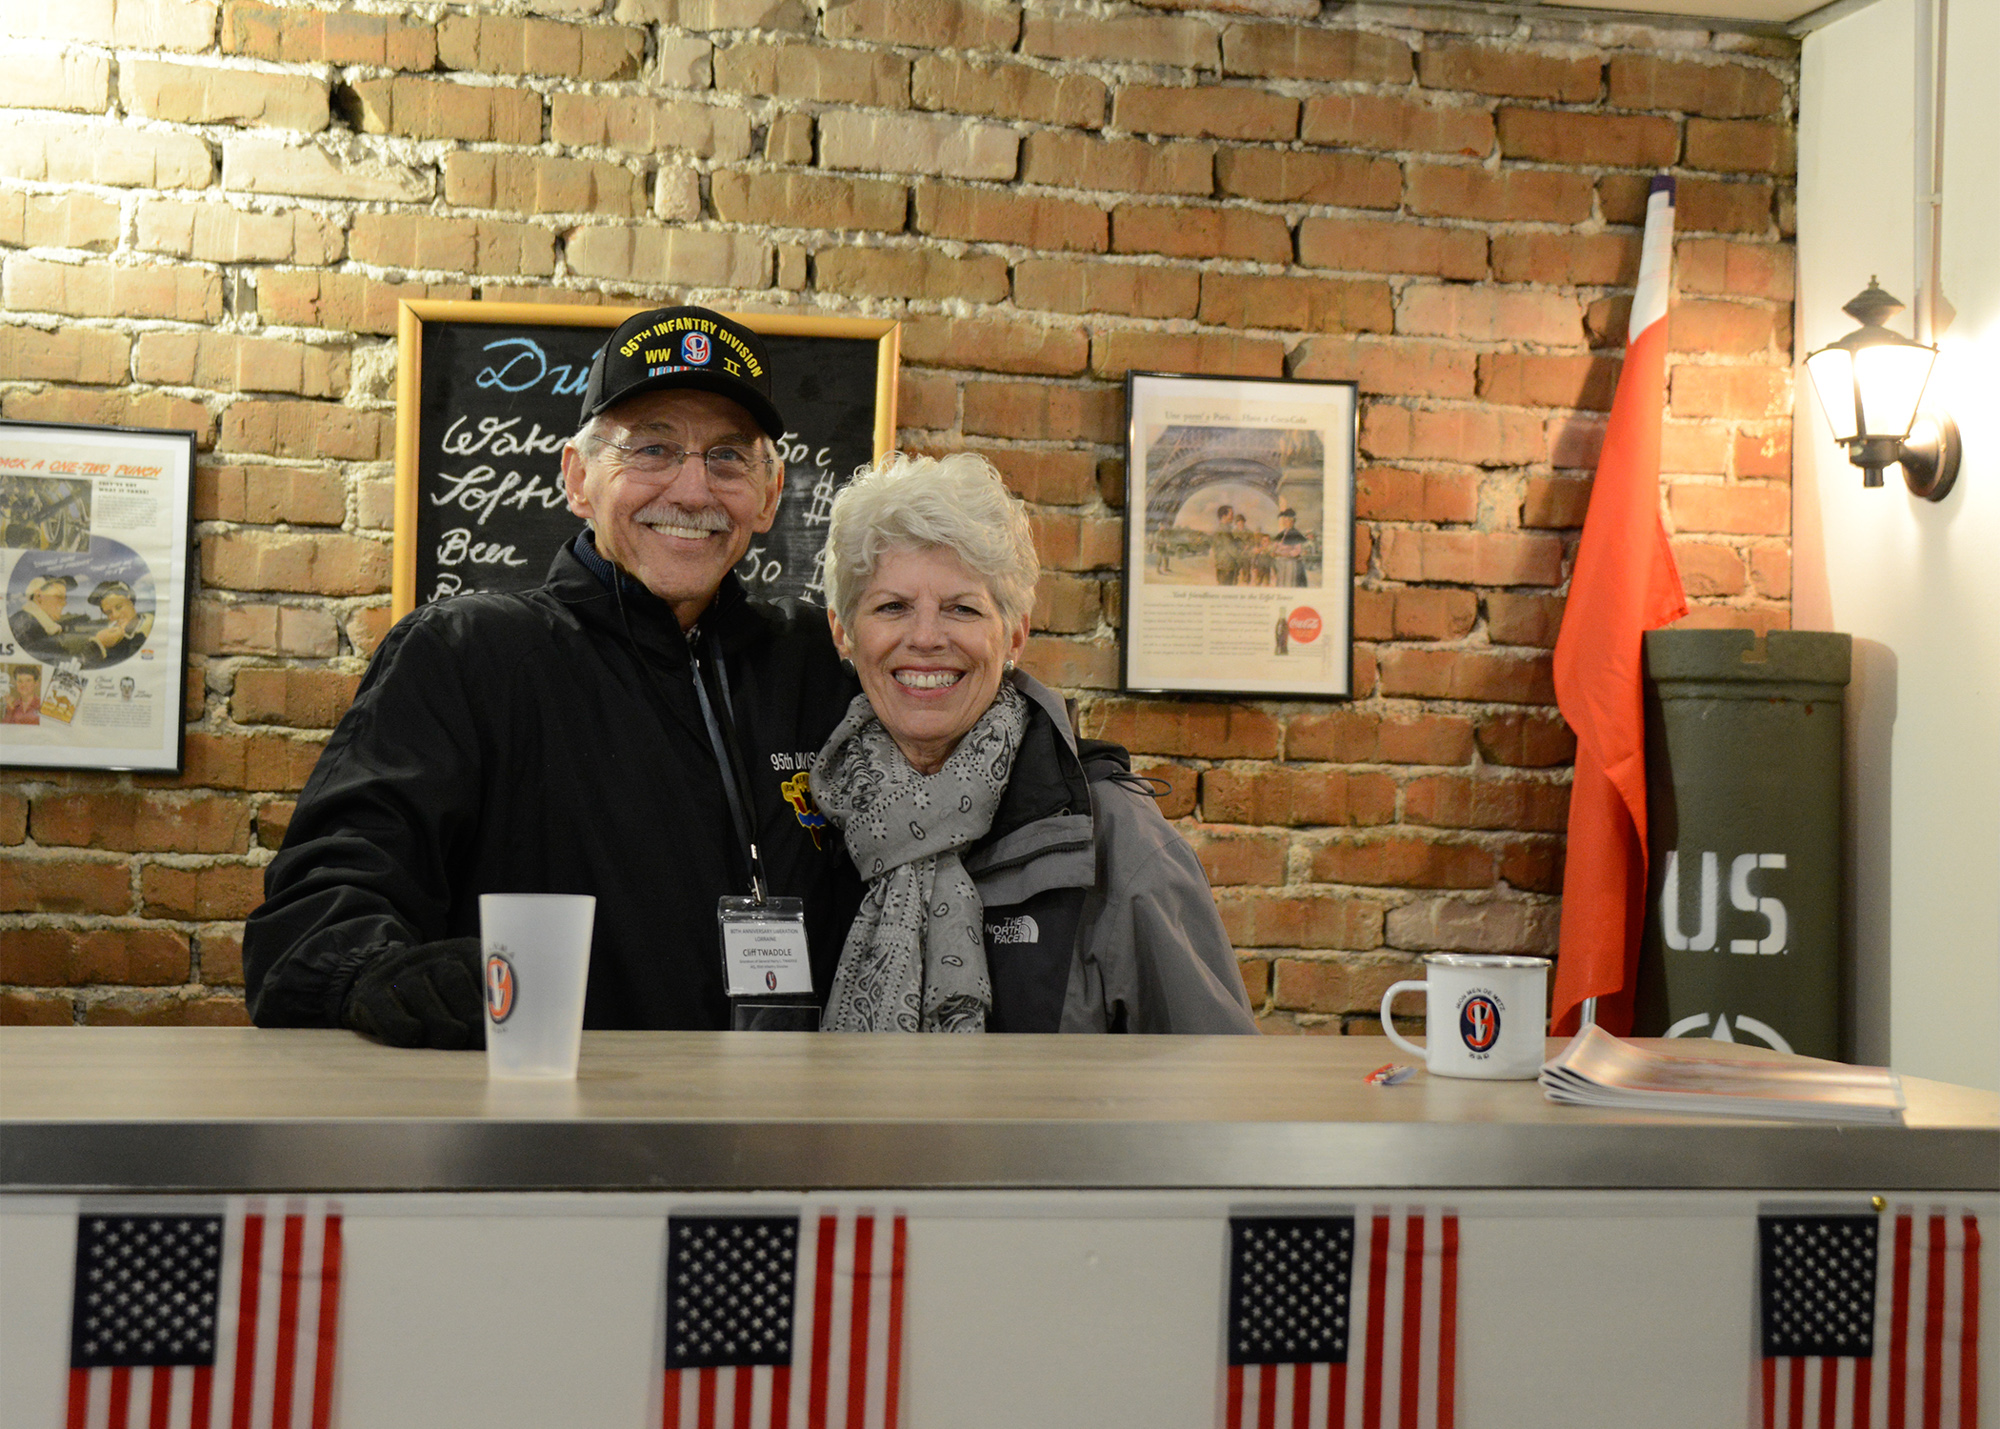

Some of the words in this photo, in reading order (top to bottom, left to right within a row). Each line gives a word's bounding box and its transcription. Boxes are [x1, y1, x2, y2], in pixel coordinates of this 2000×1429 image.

[620, 329, 652, 358] 95TH
[653, 316, 718, 336] INFANTRY
[719, 329, 763, 378] DIVISION
[645, 348, 671, 364] WW
[476, 338, 601, 395] Dri
[723, 357, 741, 377] II
[441, 415, 572, 456] Wate
[32, 459, 45, 470] A
[49, 461, 111, 474] ONE-TWO
[114, 464, 163, 478] PUNCH
[770, 752, 794, 771] 95th
[794, 751, 819, 770] DIVIS
[985, 923, 1021, 935] NORTH
[1004, 917, 1023, 926] THE
[993, 934, 1021, 944] FACE
[757, 948, 792, 957] TWADDLE
